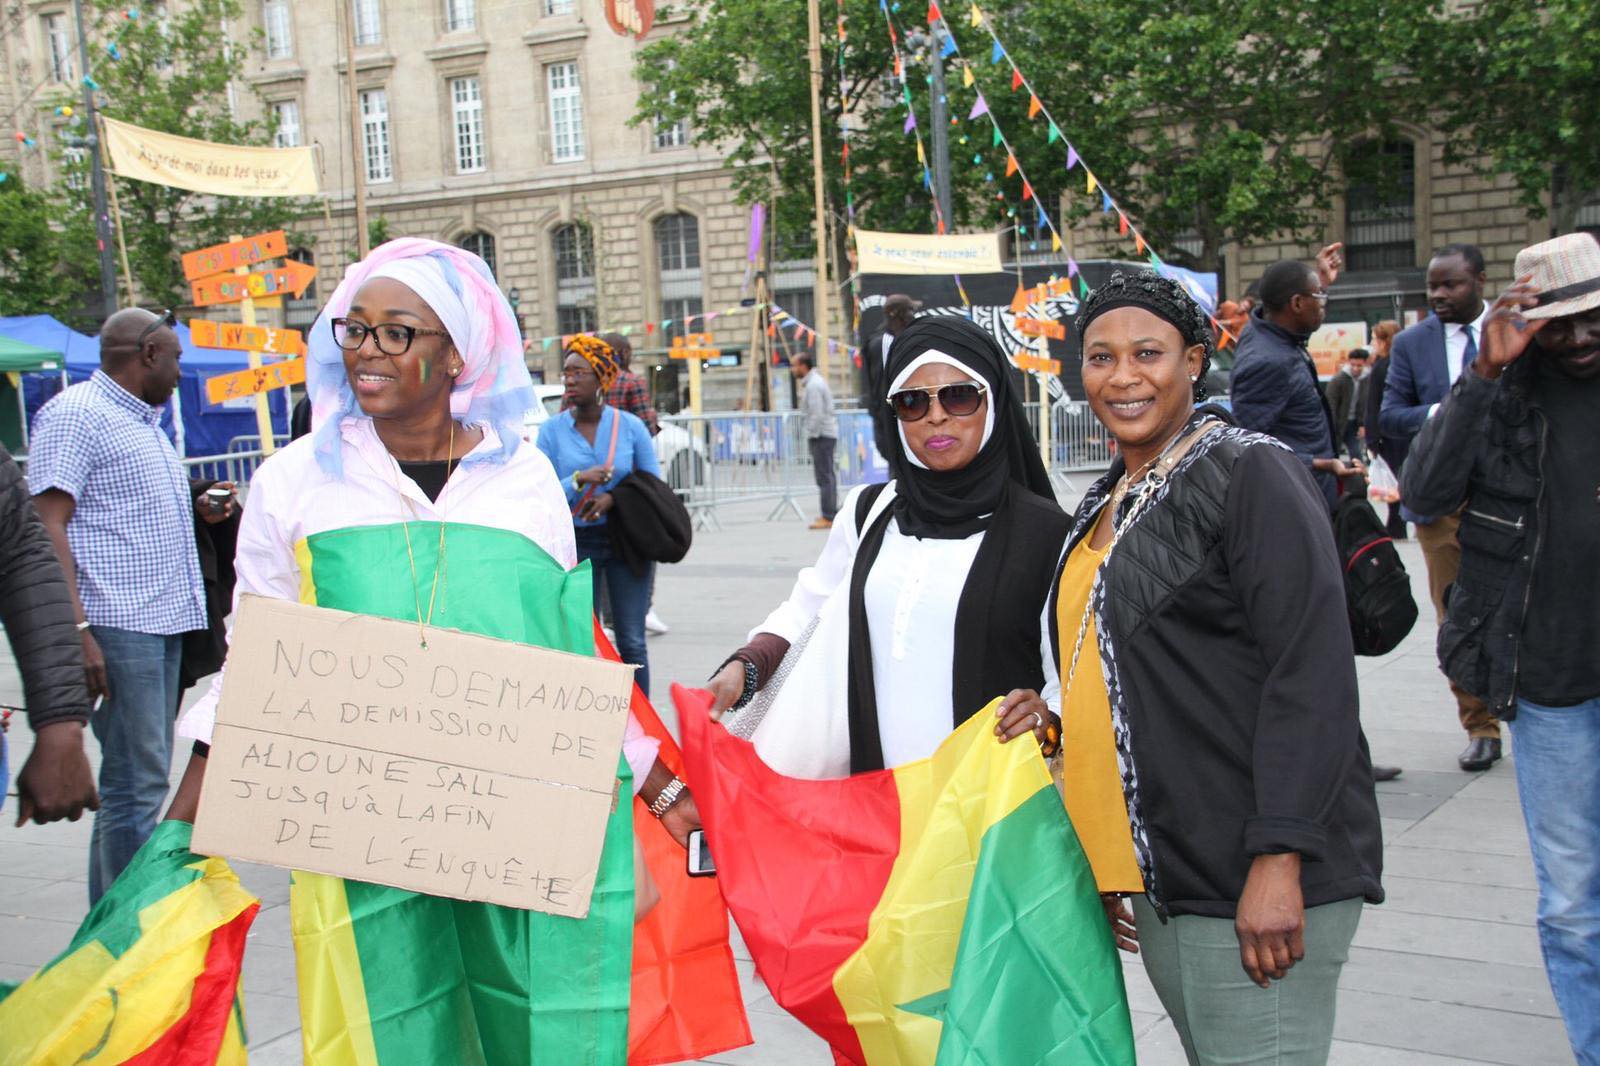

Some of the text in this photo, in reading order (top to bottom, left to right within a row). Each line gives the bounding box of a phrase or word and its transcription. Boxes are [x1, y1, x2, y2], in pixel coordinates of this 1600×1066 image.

[206, 160, 230, 178] dans
[253, 168, 280, 184] yeux
[273, 639, 629, 715] NOUS DEMANDONS
[262, 691, 317, 722] LA
[551, 731, 597, 760] DE
[241, 743, 509, 799] ALIOUNE SALL
[275, 818, 334, 850] DE
